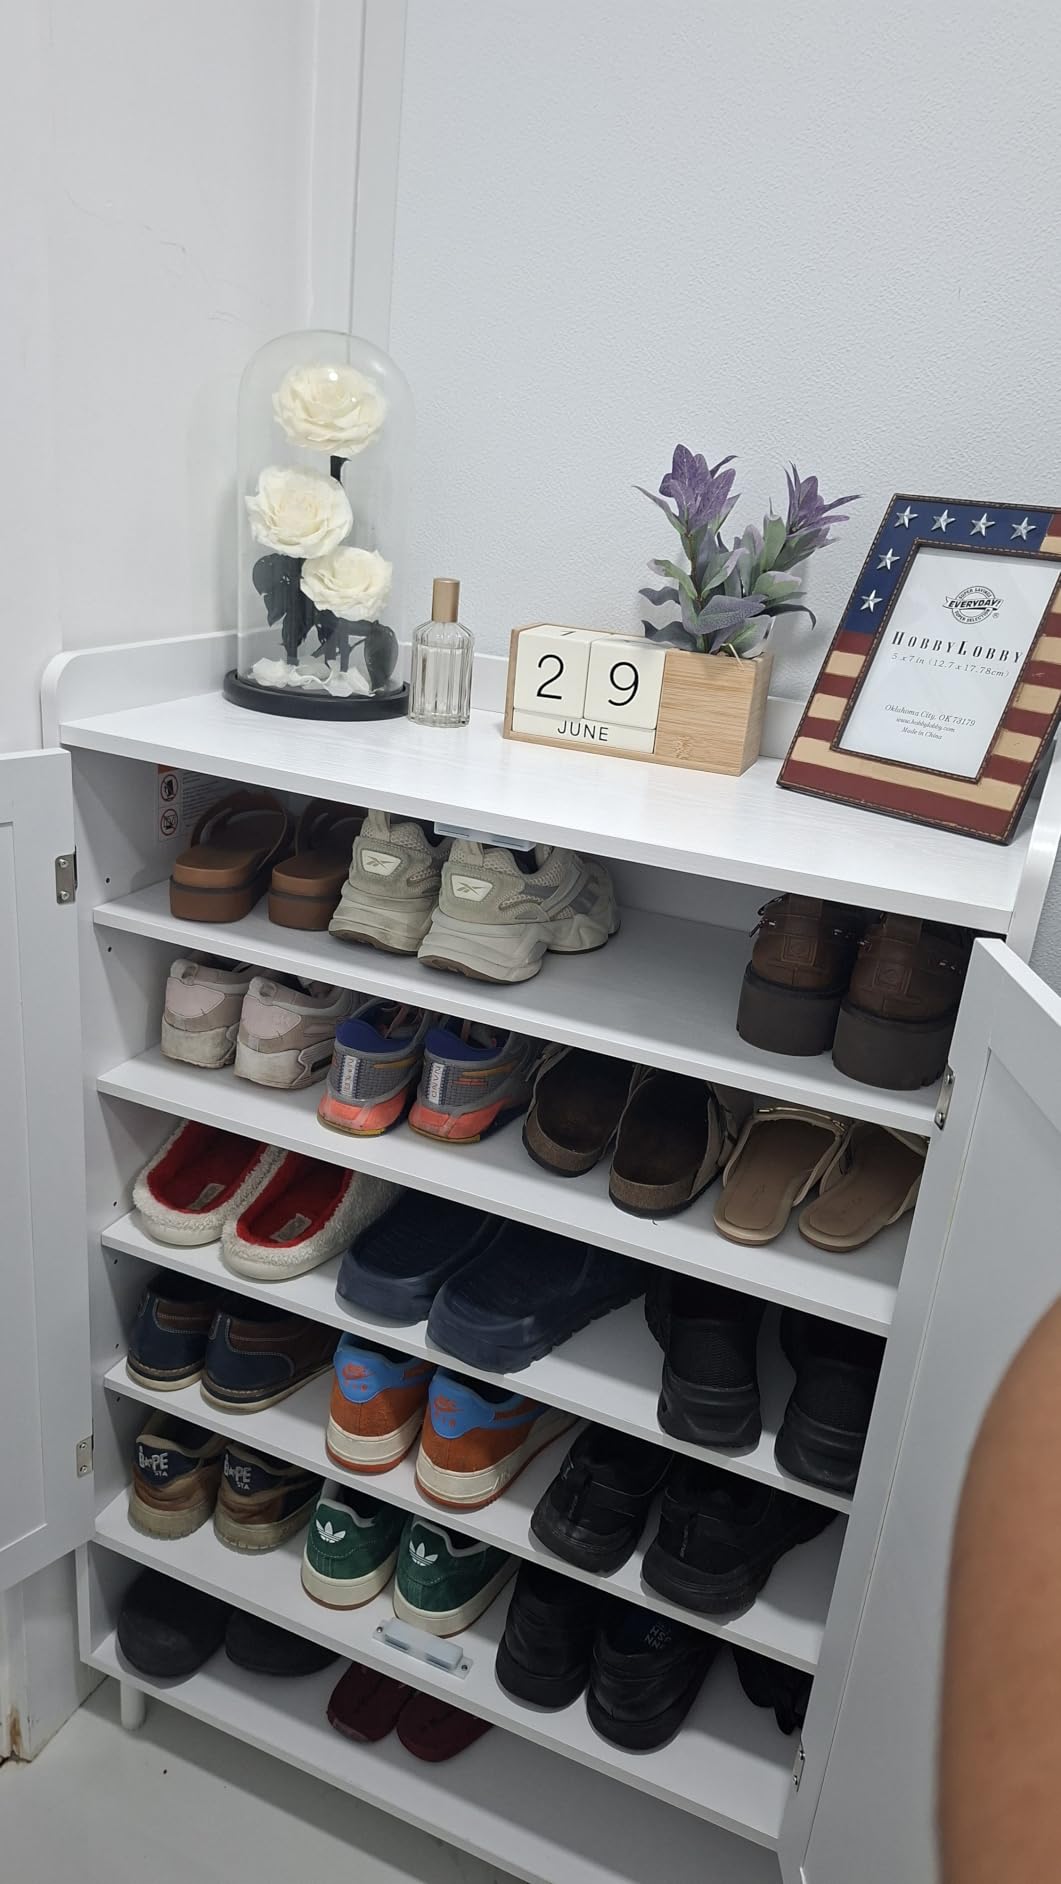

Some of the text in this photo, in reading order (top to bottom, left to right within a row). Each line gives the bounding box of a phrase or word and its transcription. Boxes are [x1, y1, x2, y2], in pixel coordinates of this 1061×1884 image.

[948, 599, 1001, 609] EVERYDAY!
[885, 704, 919, 717] Oklahoma
[938, 713, 952, 723] OK
[952, 715, 976, 727] 73179
[557, 720, 609, 742] JUNE
[902, 726, 918, 736] Made
[924, 731, 943, 740] China
